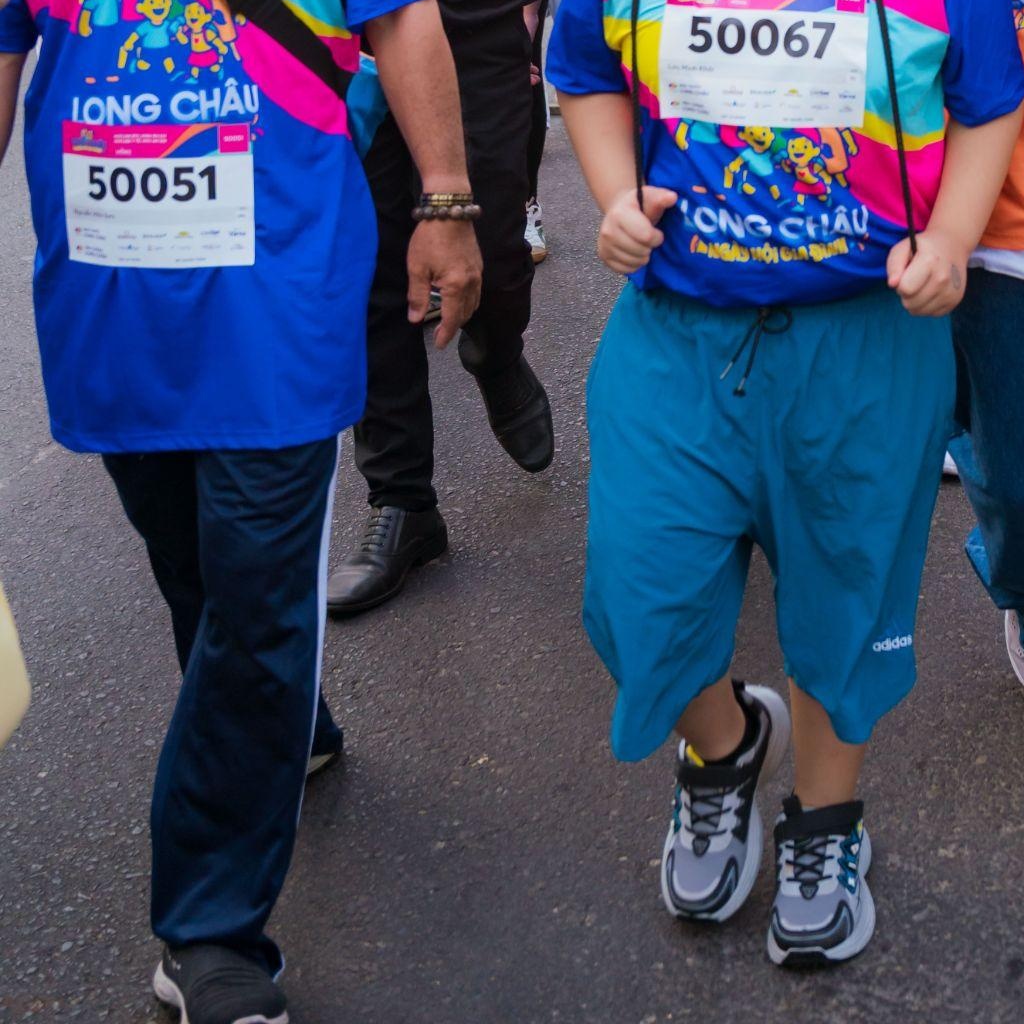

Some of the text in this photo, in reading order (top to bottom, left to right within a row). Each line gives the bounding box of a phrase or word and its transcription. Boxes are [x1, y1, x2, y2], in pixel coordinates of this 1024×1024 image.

[688, 15, 836, 60] 50067
[72, 77, 259, 126] LONG CHÂU
[88, 164, 217, 203] 50051
[680, 198, 869, 240] LONG CHÂU
